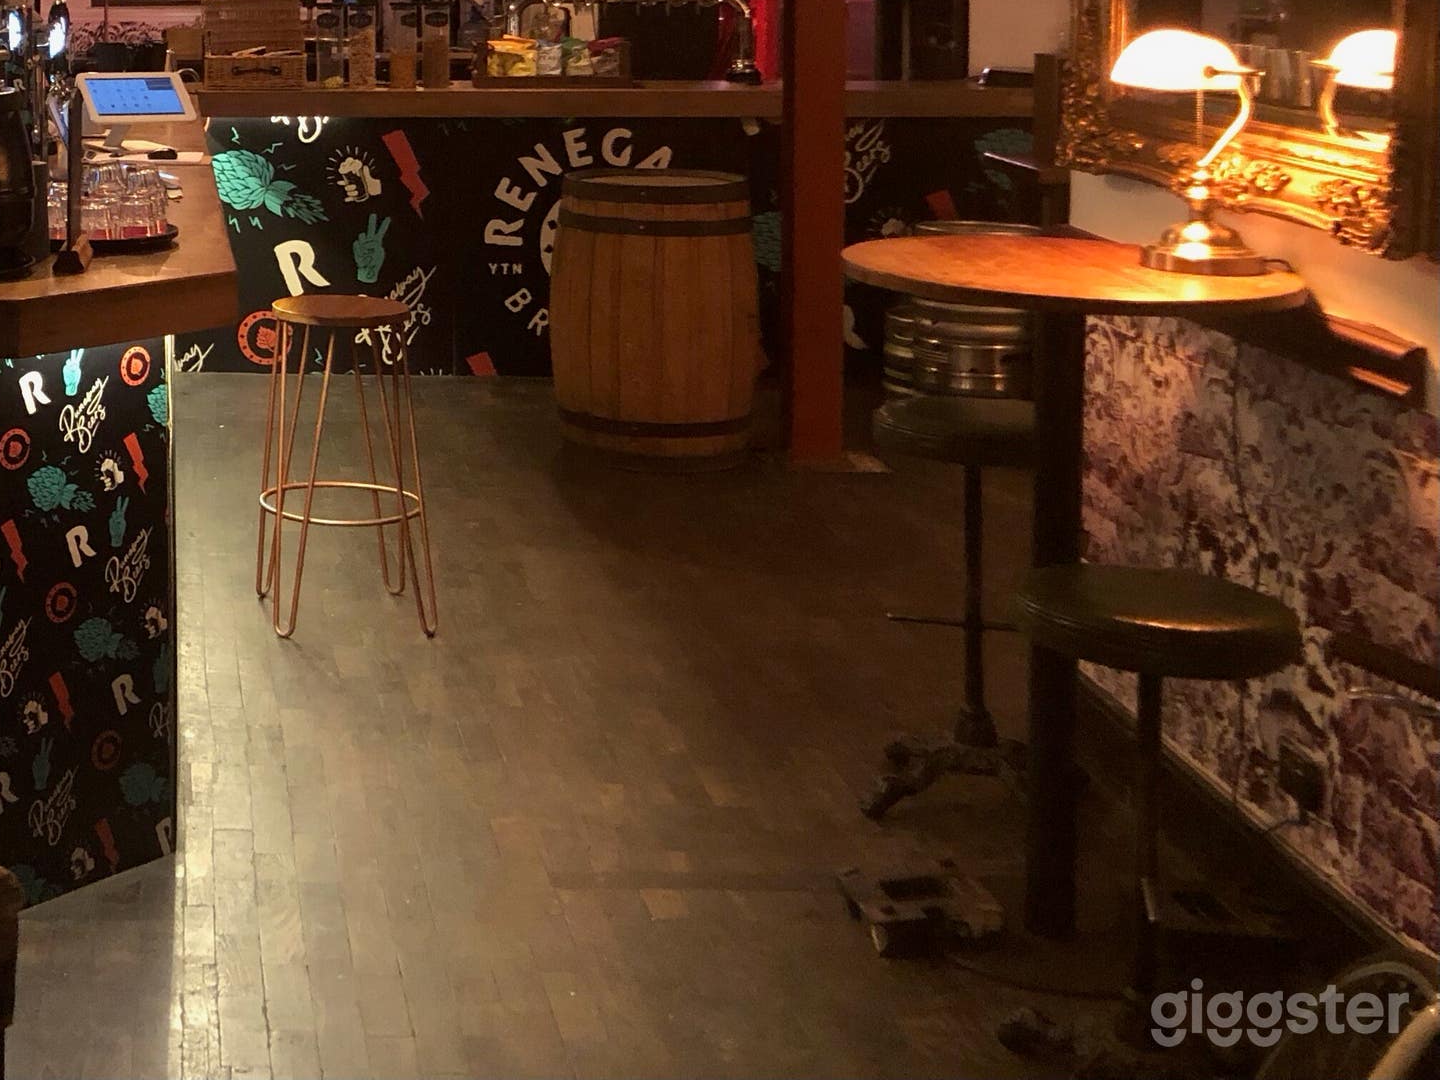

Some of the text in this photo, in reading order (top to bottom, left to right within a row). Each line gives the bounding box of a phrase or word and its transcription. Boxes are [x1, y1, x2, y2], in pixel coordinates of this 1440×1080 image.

[484, 128, 673, 245] RENEGA
[273, 239, 330, 296] R
[488, 262, 523, 275] YTN
[504, 287, 550, 337] BR
[19, 370, 52, 415] R
[59, 375, 109, 443] Runaway
[76, 404, 107, 454] Beers
[65, 525, 97, 569] R
[111, 673, 142, 716] R
